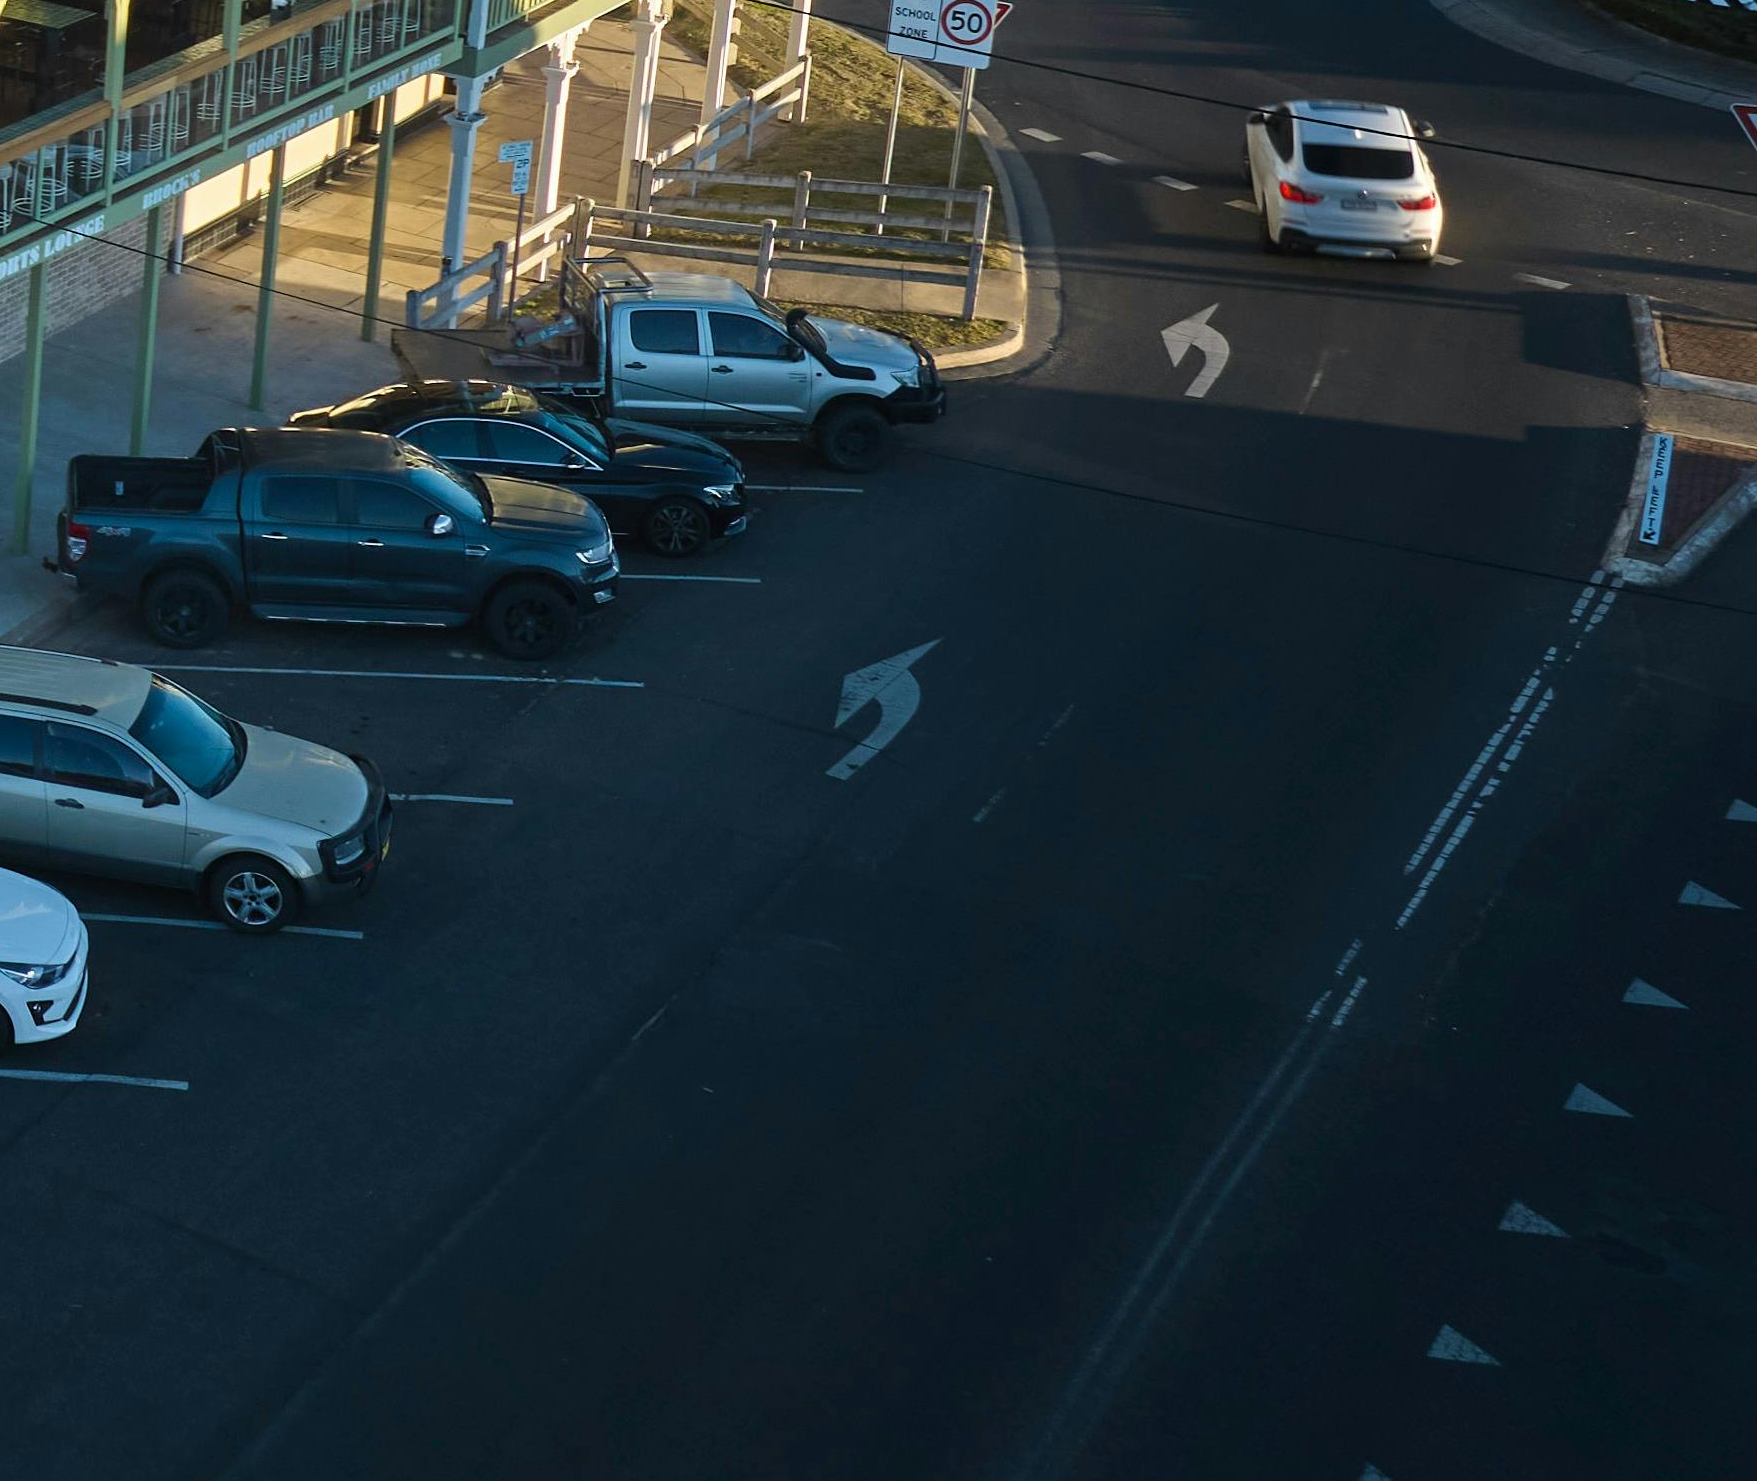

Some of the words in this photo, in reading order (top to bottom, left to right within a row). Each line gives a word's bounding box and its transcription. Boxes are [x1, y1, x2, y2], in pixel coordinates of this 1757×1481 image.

[895, 6, 936, 22] SCHOOL
[950, 10, 983, 34] 50
[900, 26, 928, 38] ZONE
[368, 69, 407, 99] FAMILY
[246, 118, 306, 159] ROOFTOP
[44, 215, 105, 258] LOUNGE
[1654, 437, 1667, 479] KEEP
[1647, 485, 1661, 527] LEFT
